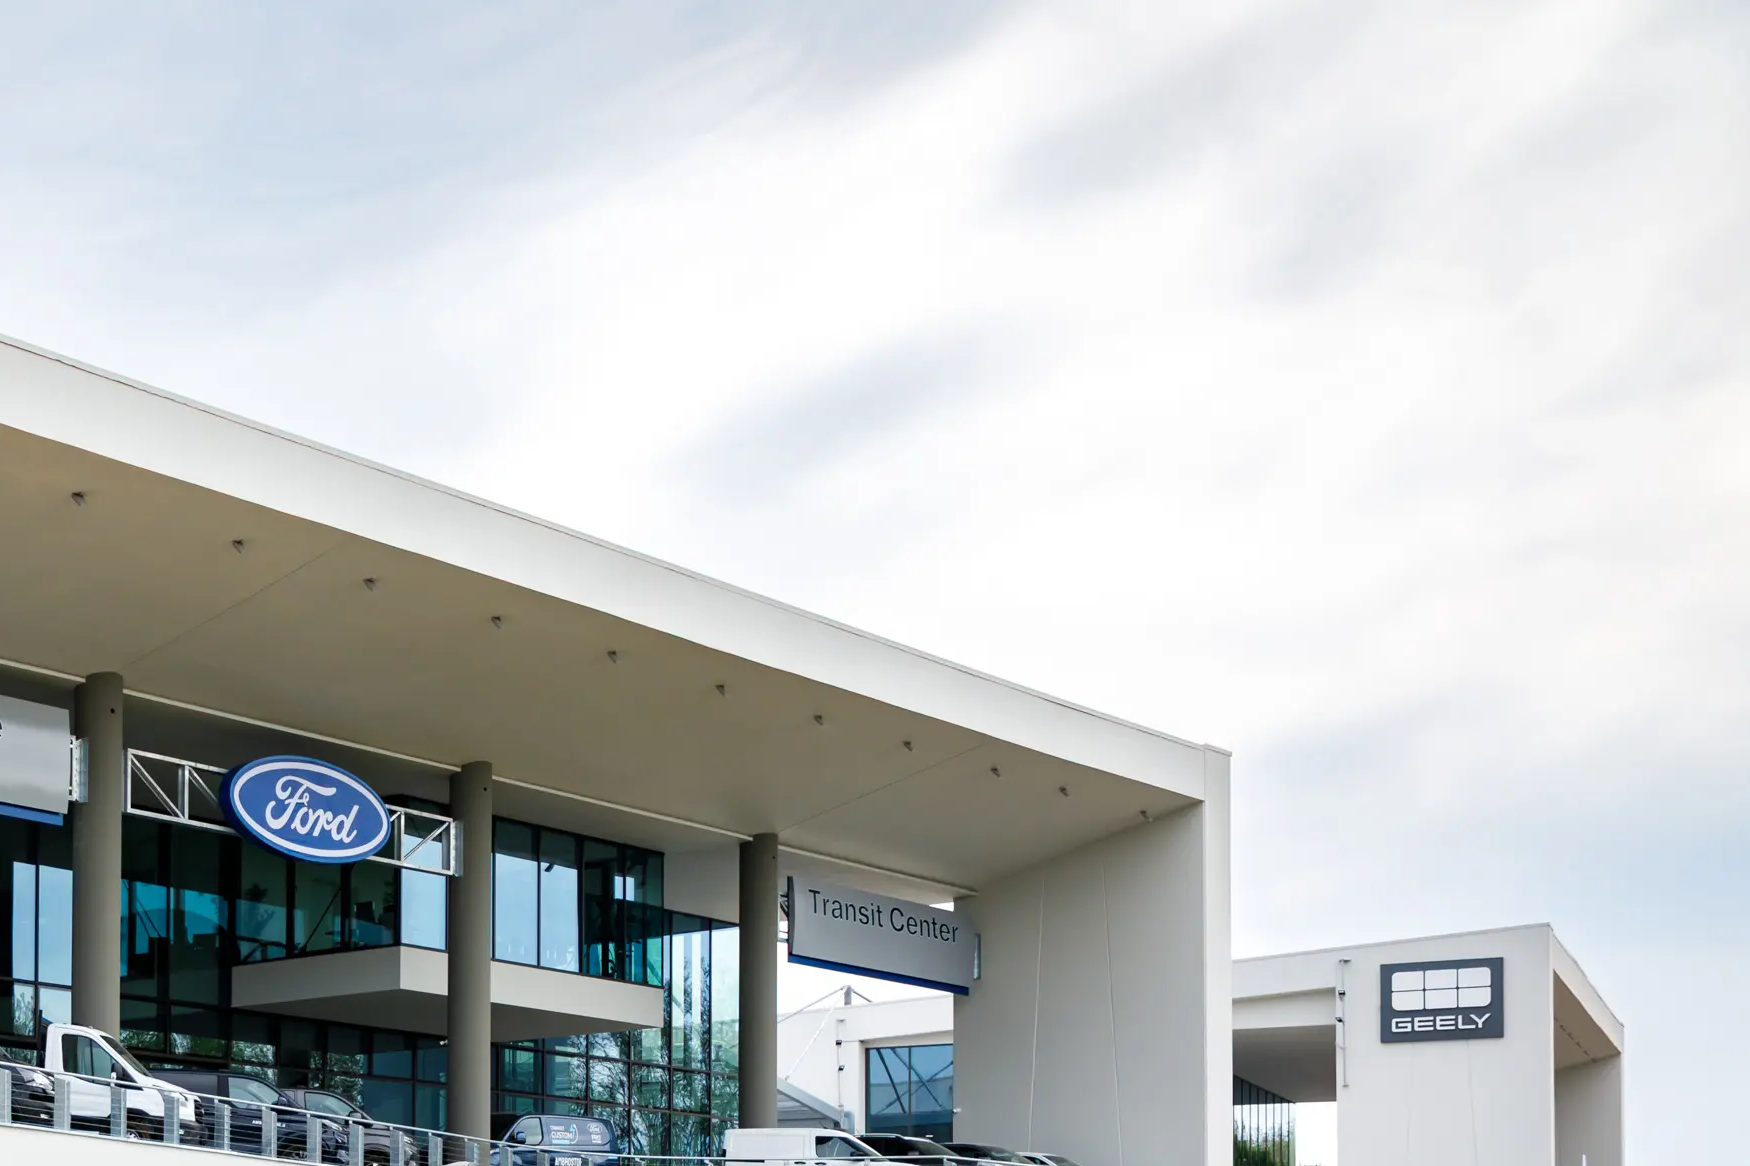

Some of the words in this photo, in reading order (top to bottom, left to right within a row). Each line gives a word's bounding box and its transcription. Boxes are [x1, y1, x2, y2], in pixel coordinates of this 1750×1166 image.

[265, 775, 360, 844] Ford
[808, 888, 884, 928] Transit
[889, 907, 959, 943] Center
[1391, 1012, 1492, 1033] GEELY
